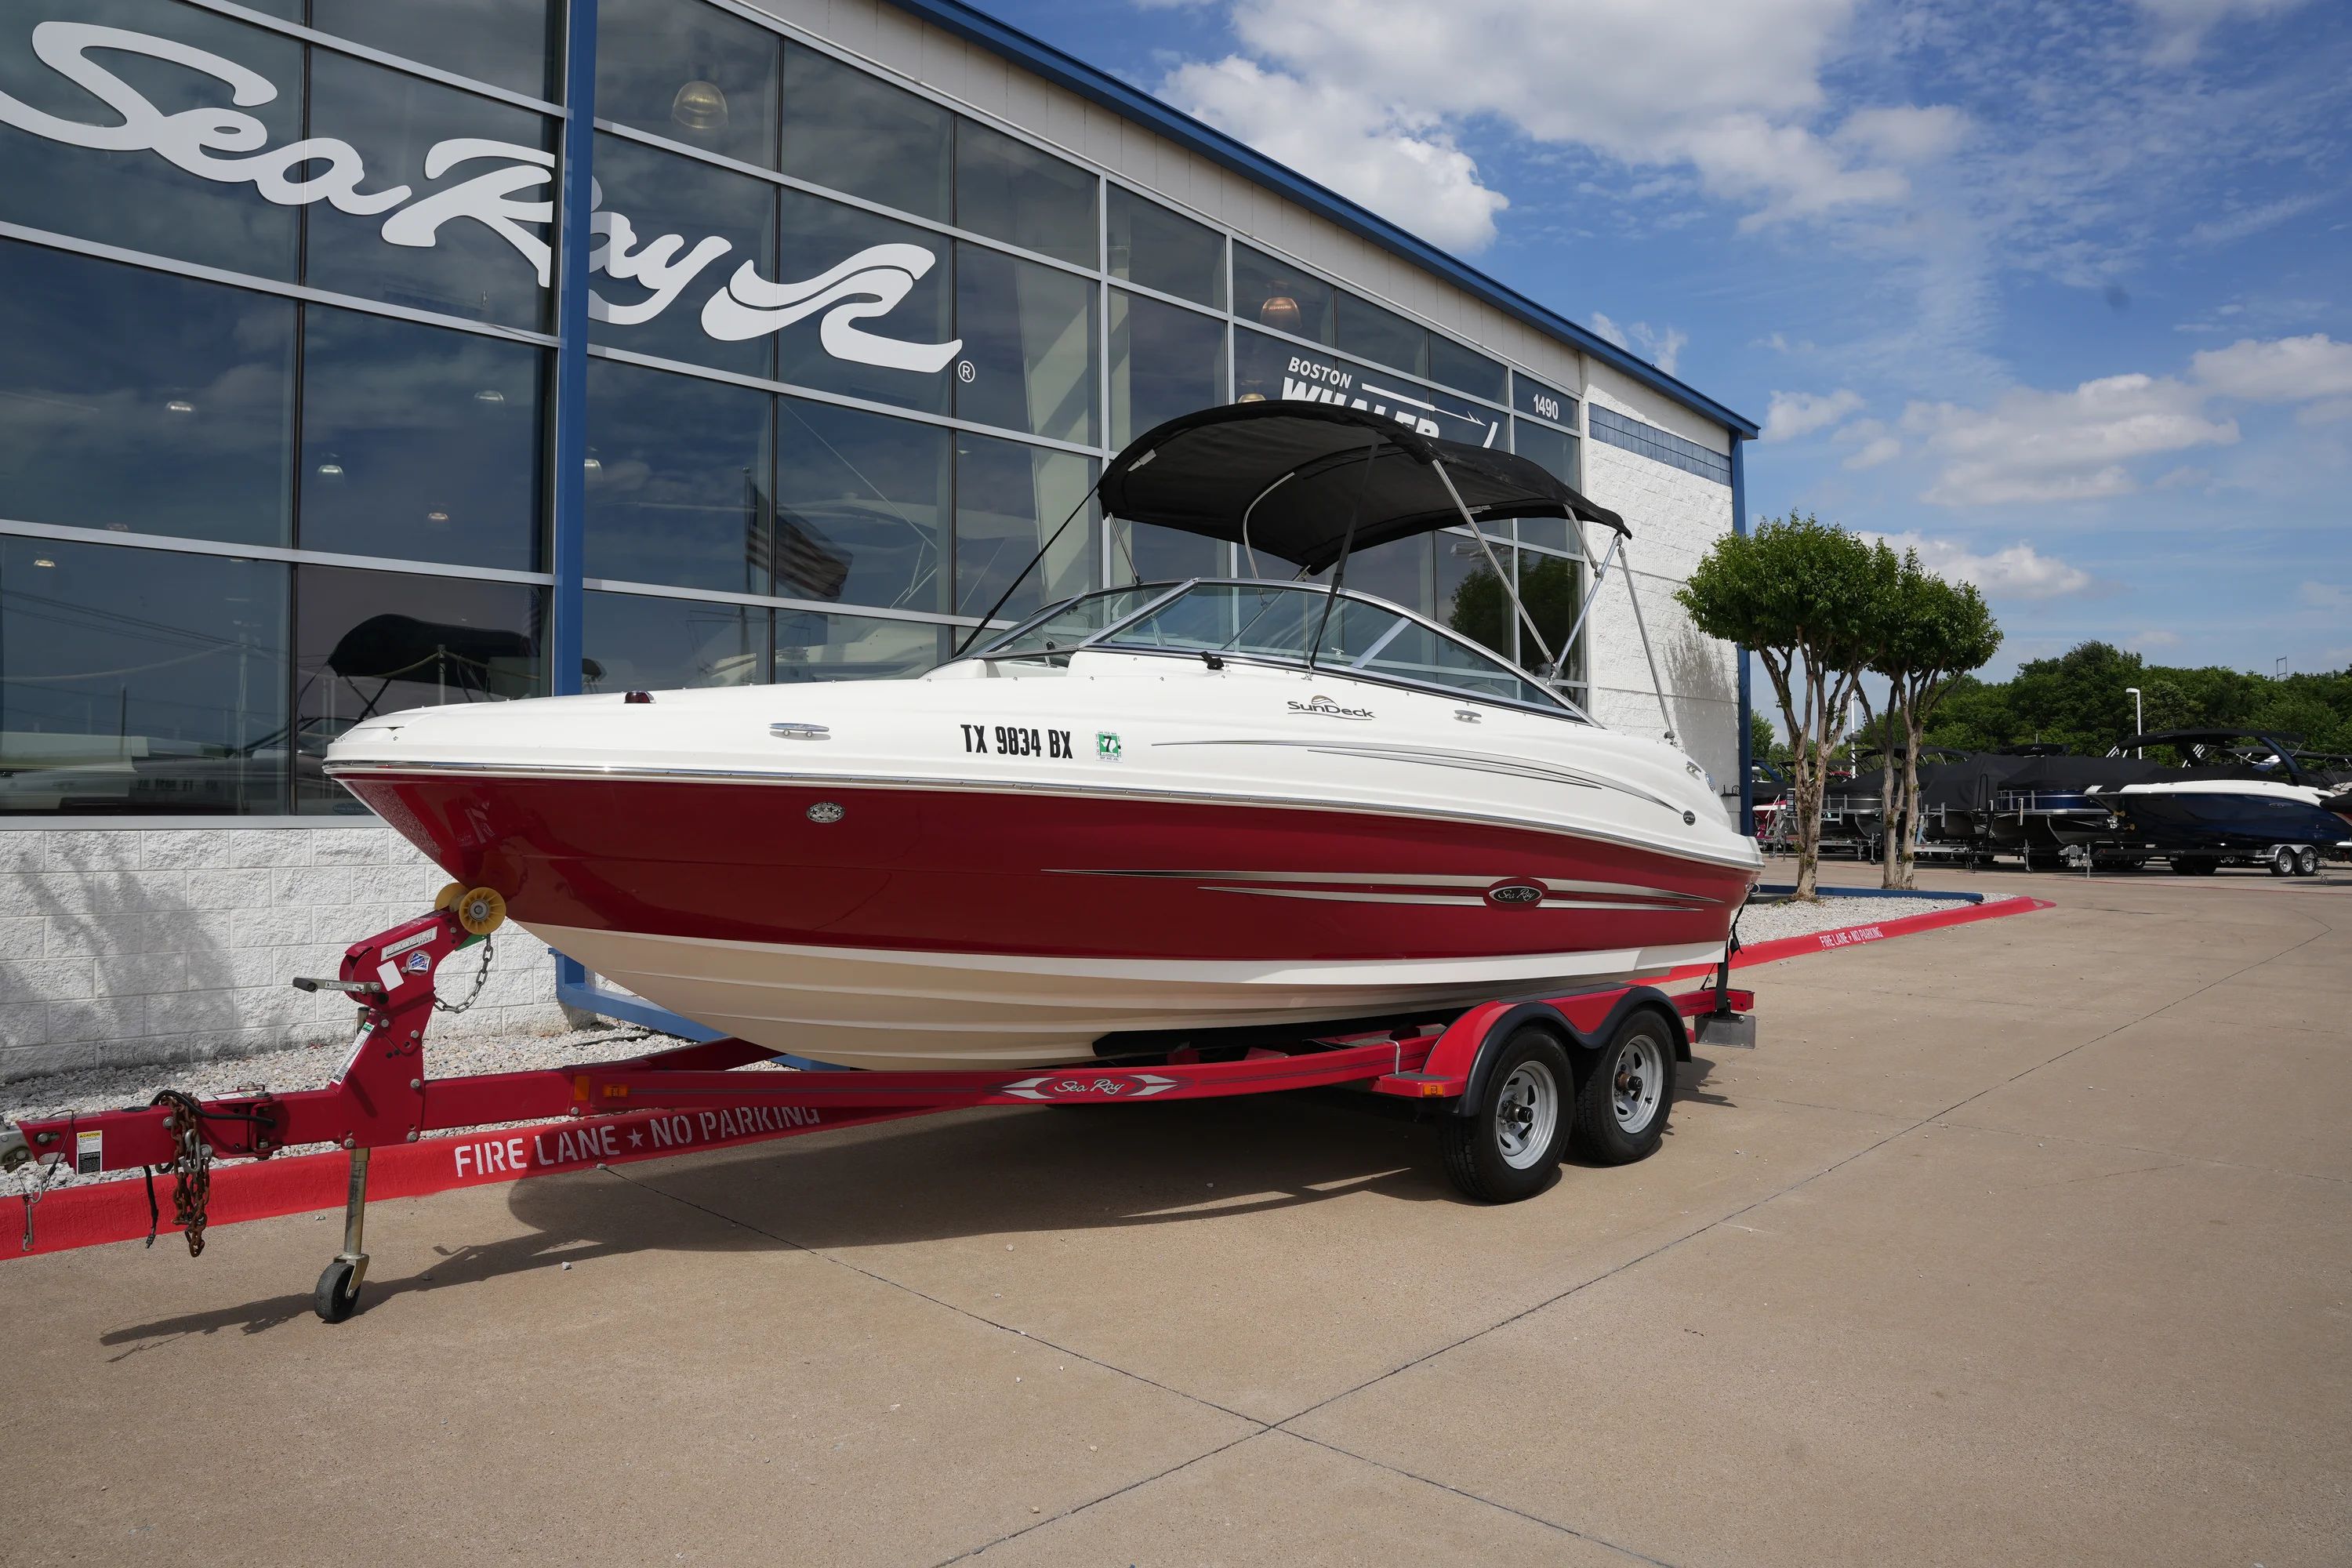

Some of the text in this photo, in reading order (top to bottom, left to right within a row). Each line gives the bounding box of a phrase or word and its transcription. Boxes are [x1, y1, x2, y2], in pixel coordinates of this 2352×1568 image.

[0, 20, 412, 216] Sea
[1288, 357, 1352, 389] BOSTON
[1534, 394, 1559, 419] 1490
[1287, 701, 1377, 718] SunDeck
[960, 724, 988, 753] TX
[995, 726, 1041, 757] 9834
[1048, 729, 1073, 759] BX
[1103, 735, 1112, 753] 7
[1497, 888, 1535, 902] Sea Ray
[1819, 927, 1884, 948] FIRE LANE NO PARKING
[1054, 1079, 1126, 1095] Sea Ray
[455, 1106, 821, 1178] FIRE LANE NO PARKING
